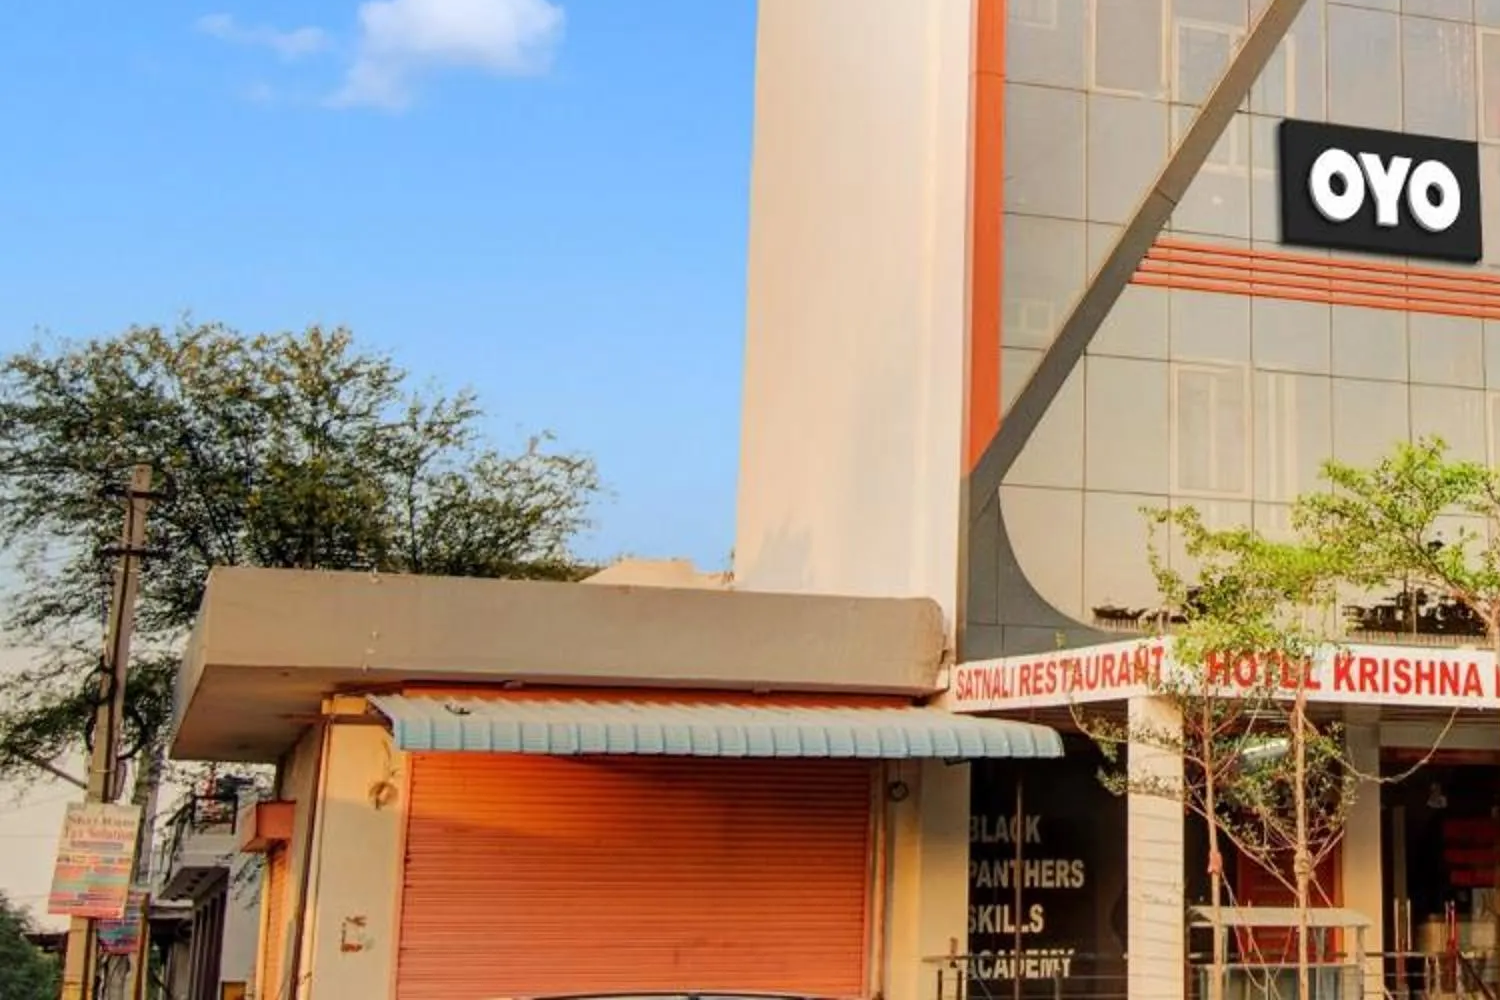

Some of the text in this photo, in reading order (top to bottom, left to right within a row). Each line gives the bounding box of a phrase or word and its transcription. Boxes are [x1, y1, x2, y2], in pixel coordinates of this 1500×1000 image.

[1308, 147, 1462, 233] OYO
[955, 645, 1165, 702] SATNALI RESTAURANT
[1205, 646, 1322, 690] HOTEL
[1333, 651, 1484, 698] KRISHNA
[970, 814, 1042, 844] BLACK
[970, 858, 1086, 889] PANTHERS
